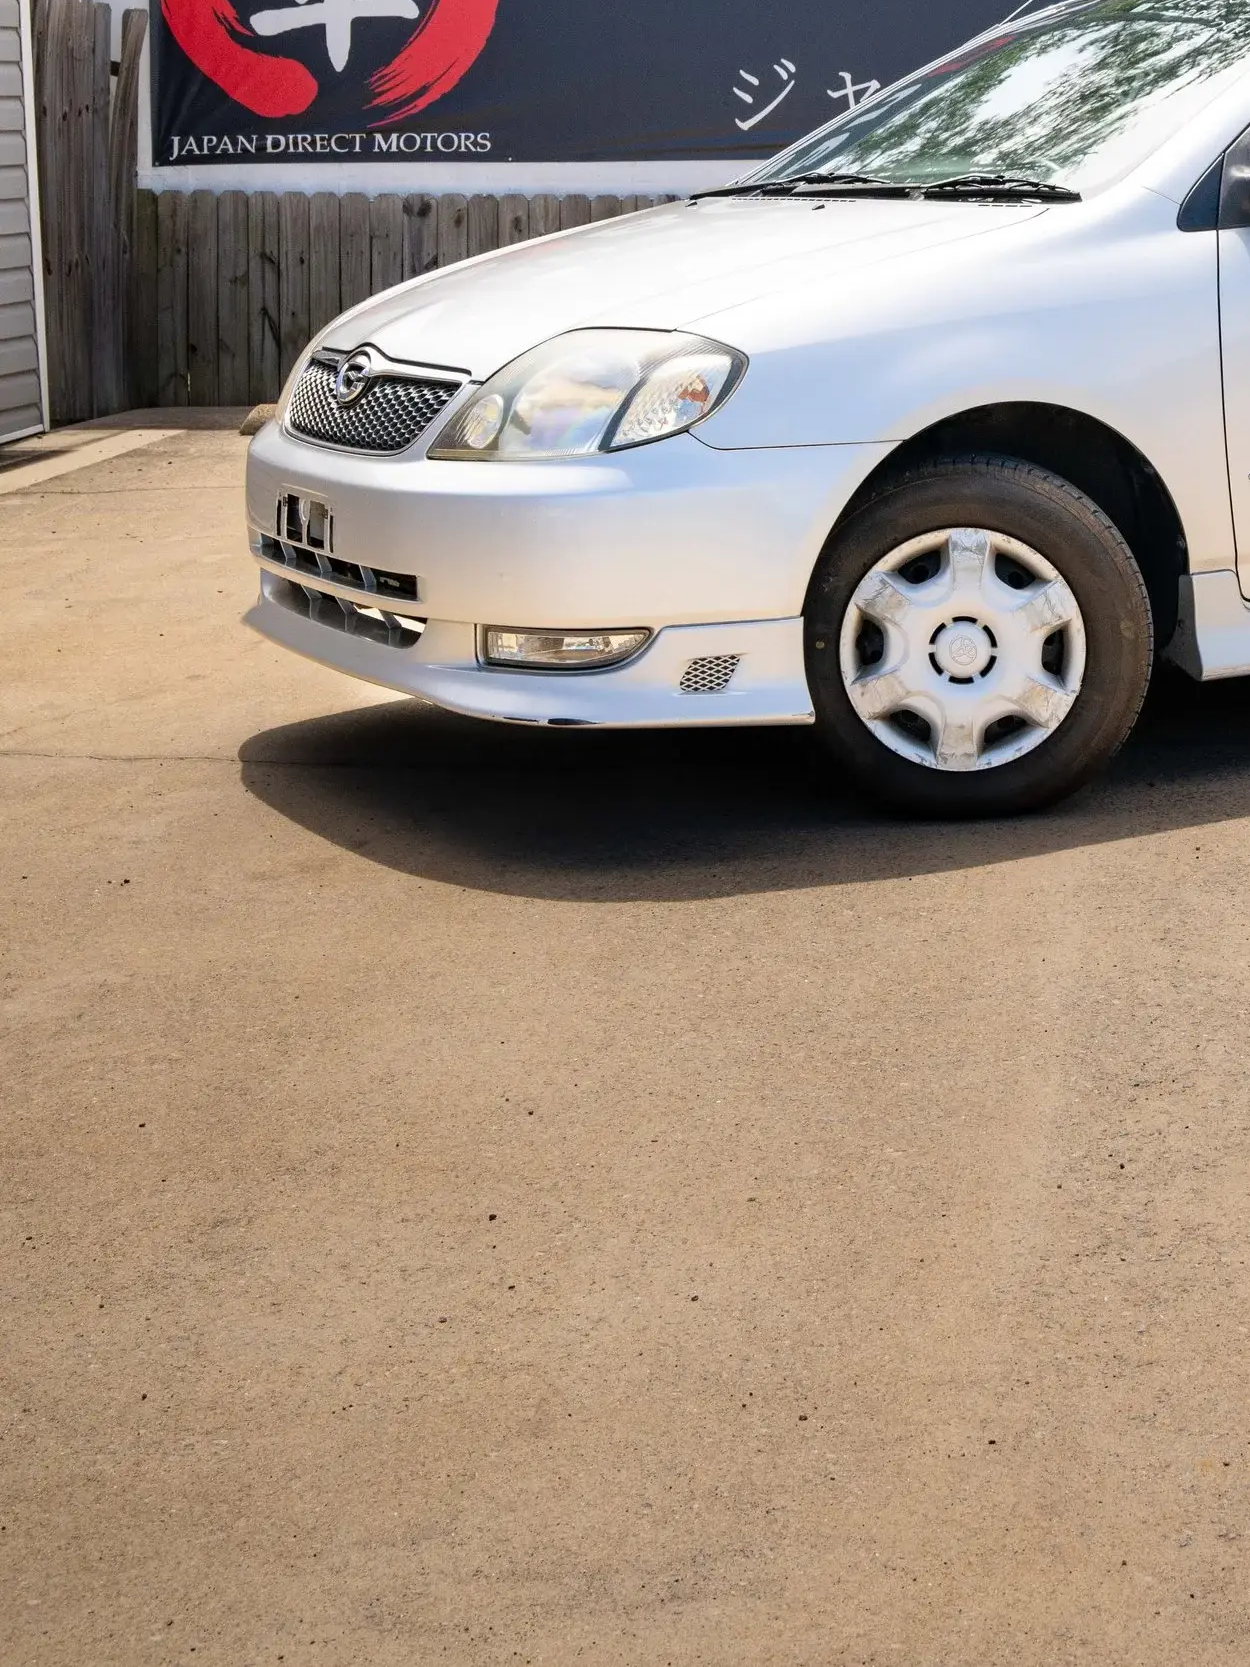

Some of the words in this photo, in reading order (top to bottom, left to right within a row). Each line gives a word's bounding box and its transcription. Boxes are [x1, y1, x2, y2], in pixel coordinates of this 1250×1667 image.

[169, 134, 258, 162] JAPAN
[265, 133, 367, 154] DIRECT
[373, 132, 492, 153] MOTORS
